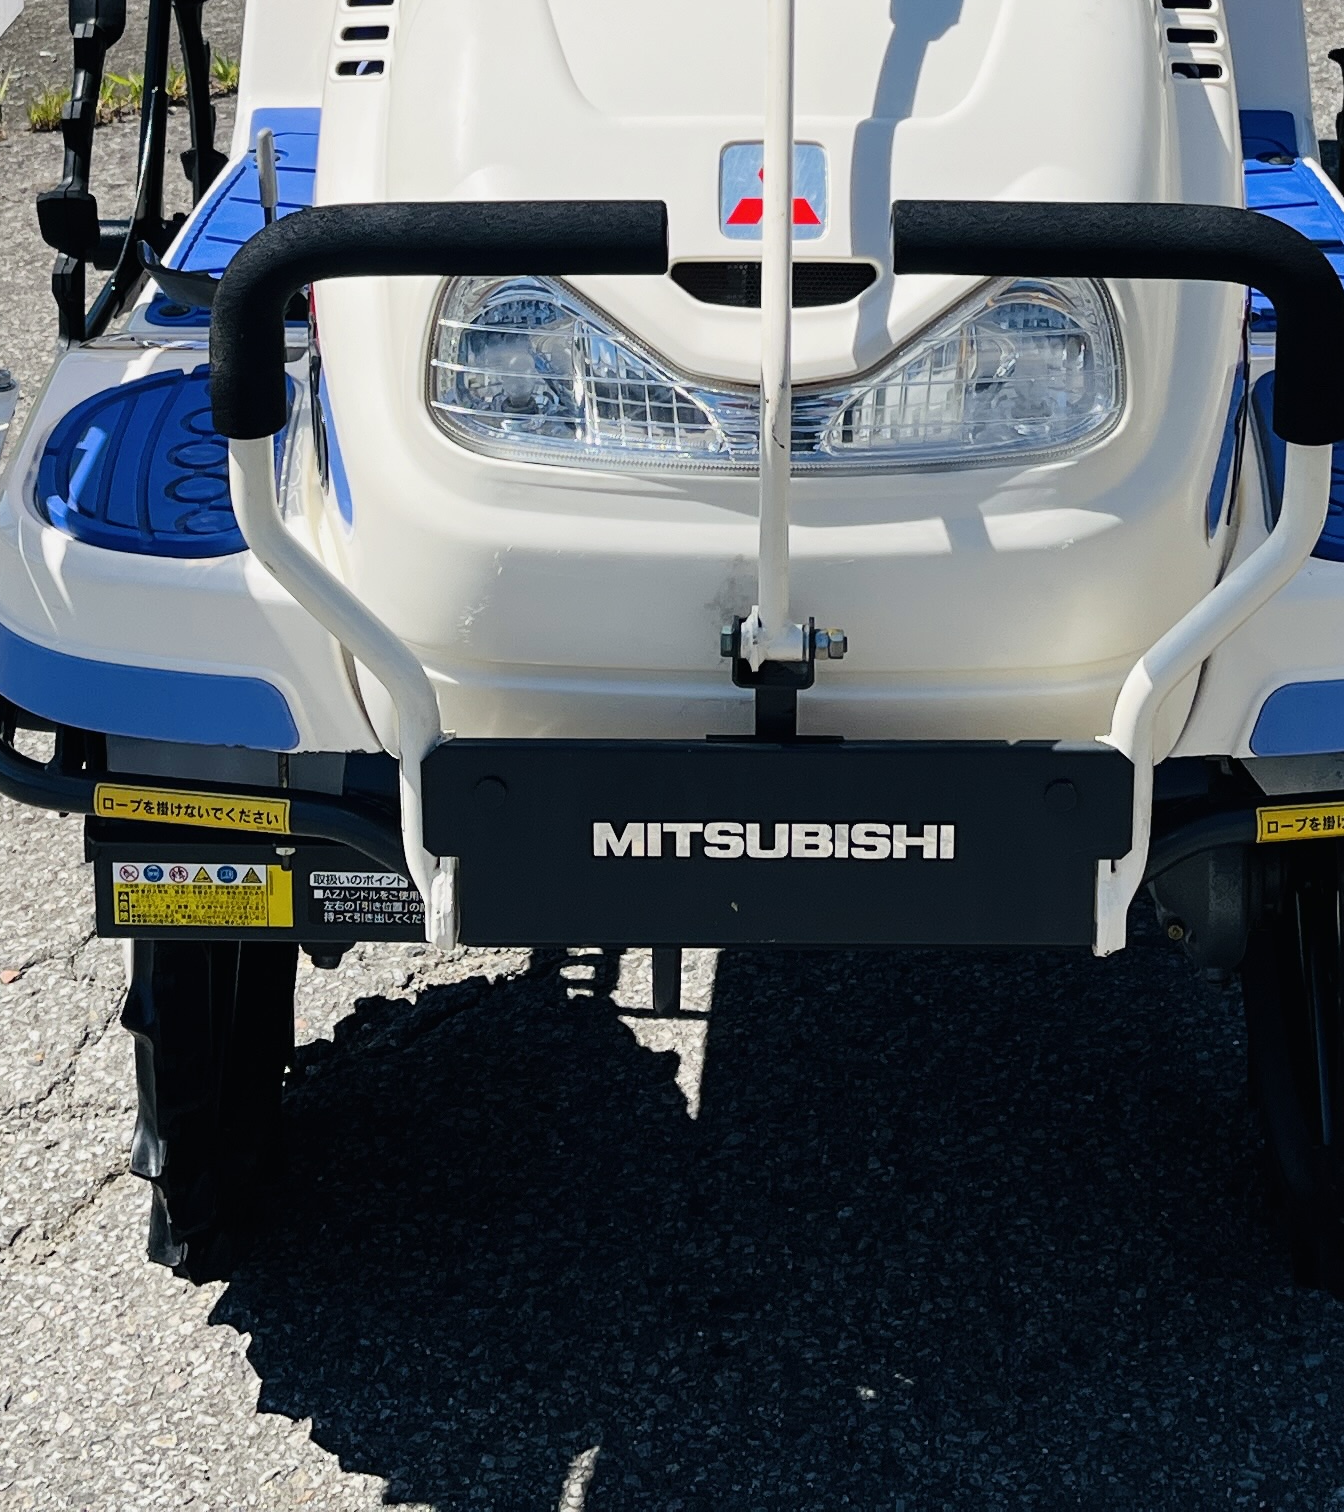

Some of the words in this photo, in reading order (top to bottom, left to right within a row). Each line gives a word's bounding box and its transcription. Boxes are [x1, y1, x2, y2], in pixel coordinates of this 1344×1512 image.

[102, 797, 279, 826] ロープを掛けないでください
[593, 822, 955, 859] MITSUBISHI
[313, 873, 406, 886] 取扱いのポイント
[323, 889, 423, 901] AZハンドルをご使用
[323, 913, 425, 924] 持って引き出してくだ
